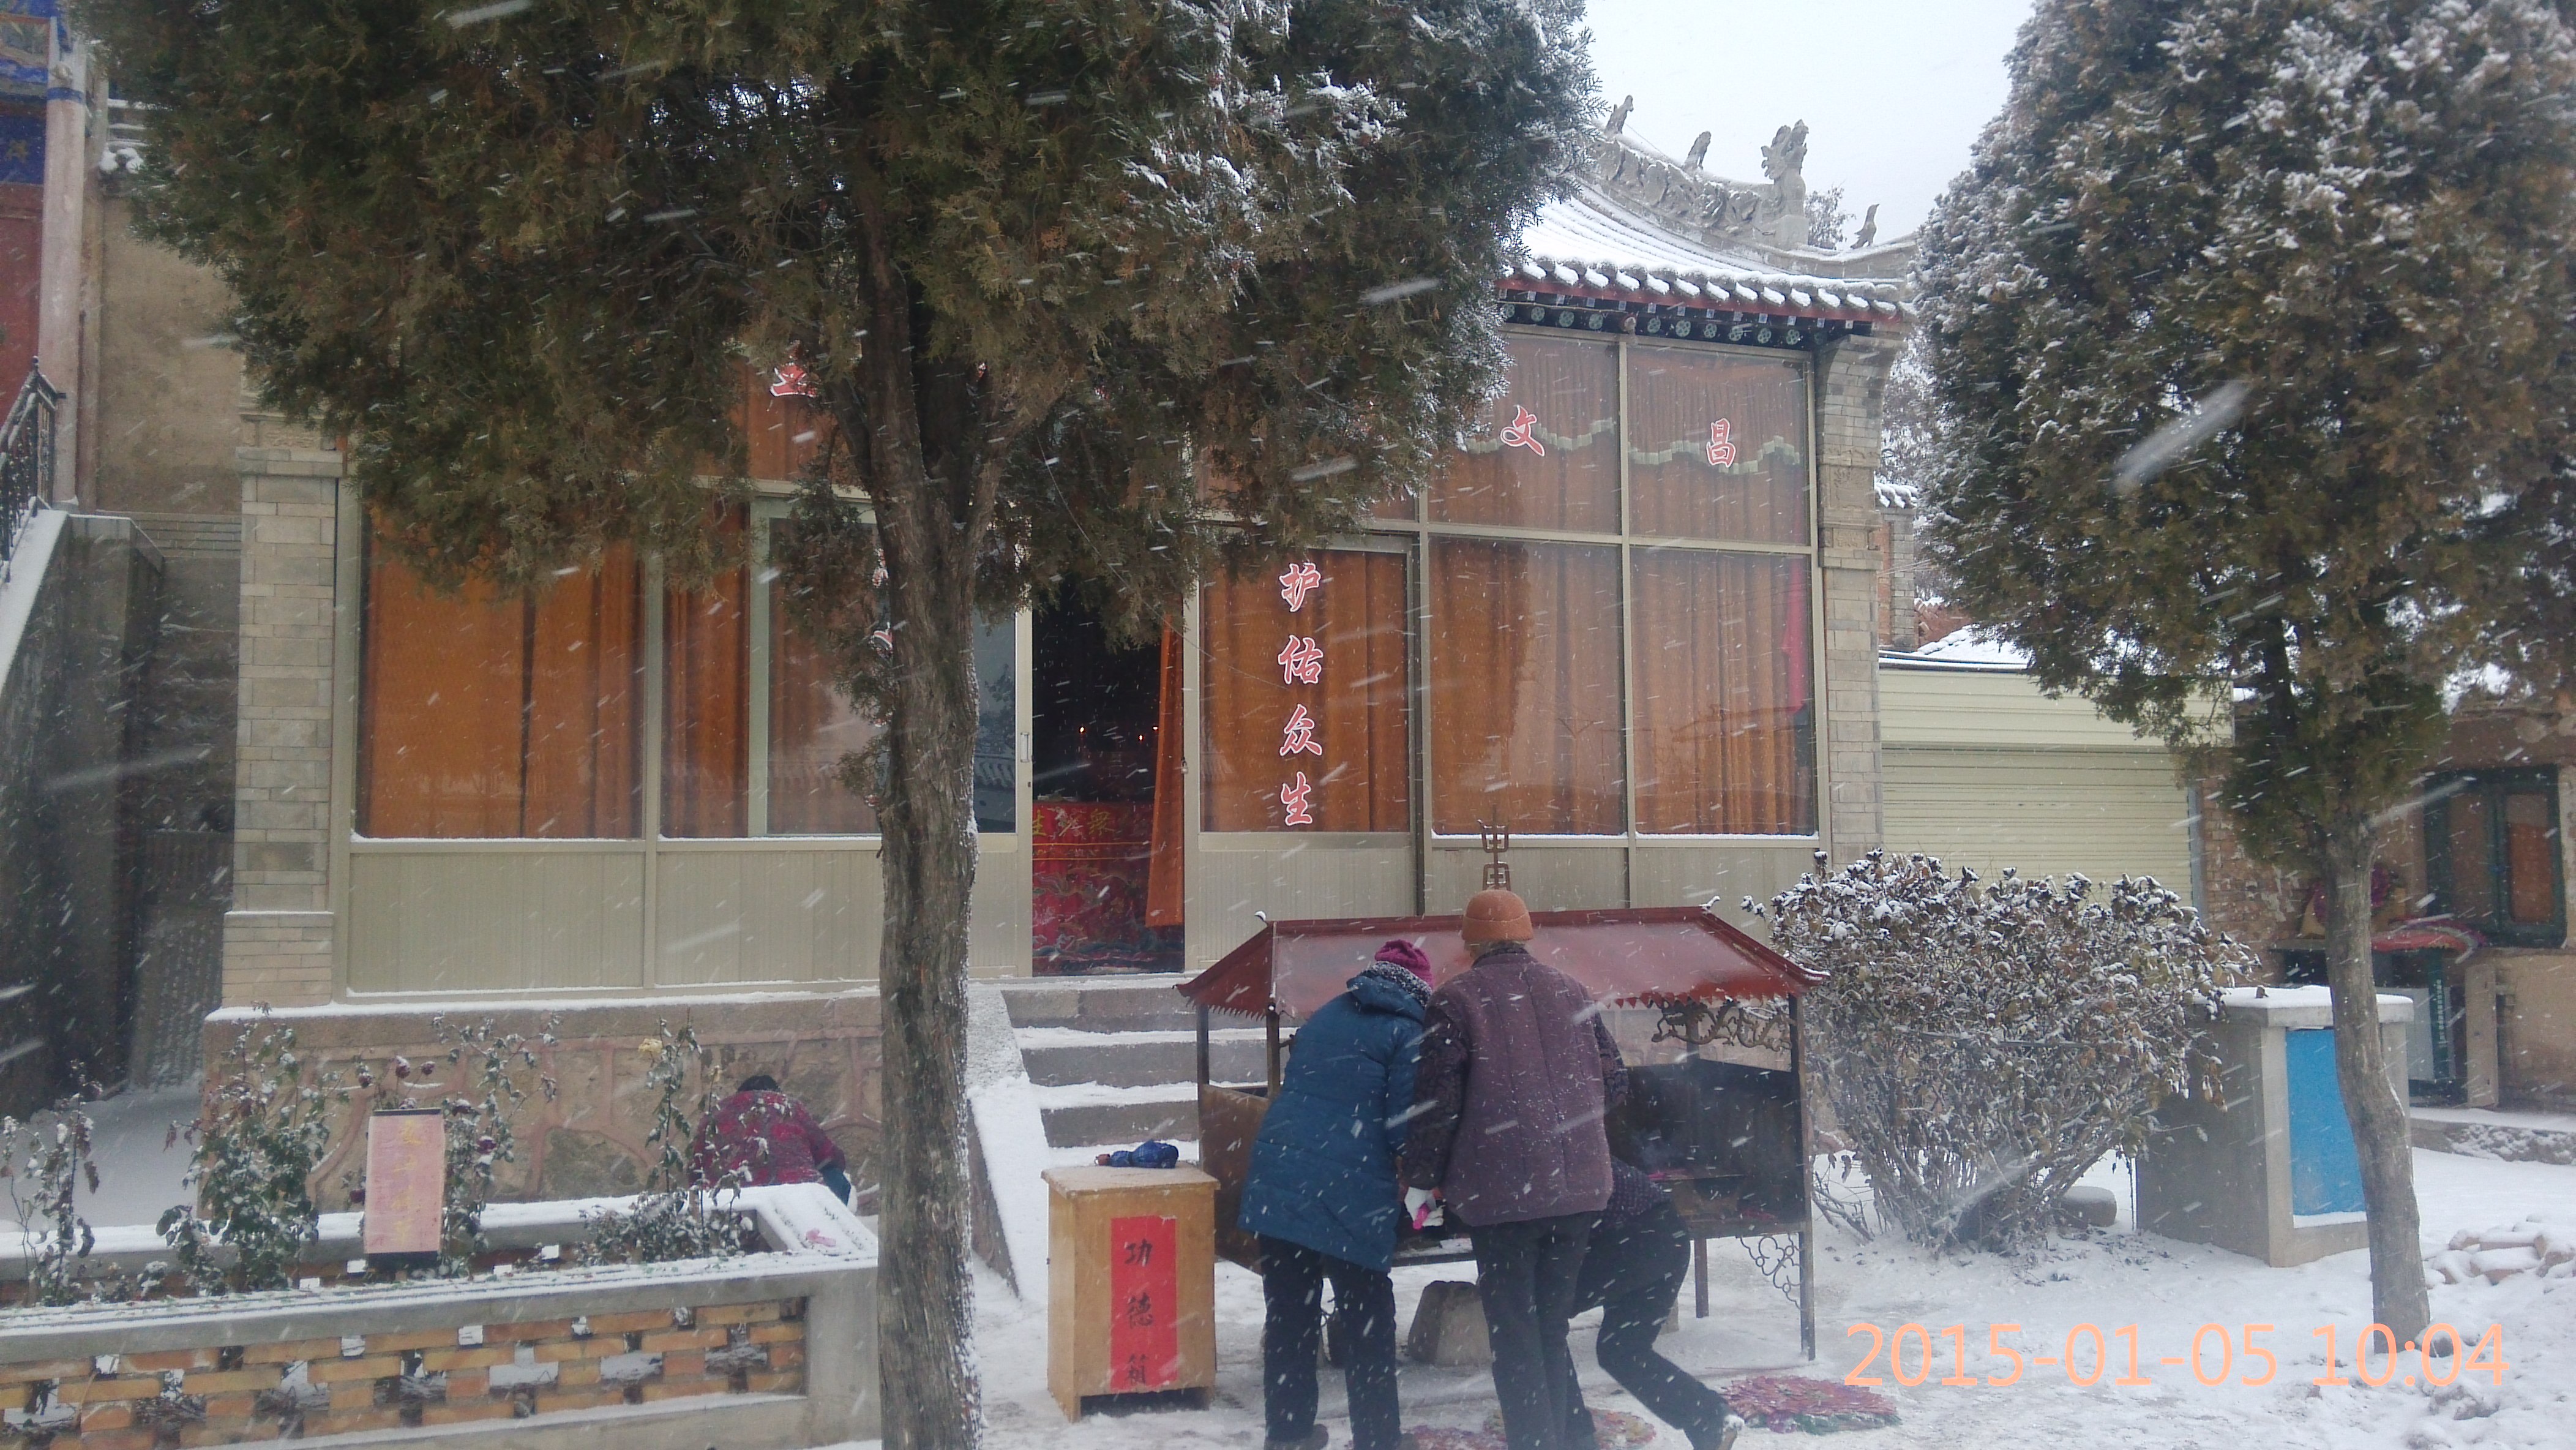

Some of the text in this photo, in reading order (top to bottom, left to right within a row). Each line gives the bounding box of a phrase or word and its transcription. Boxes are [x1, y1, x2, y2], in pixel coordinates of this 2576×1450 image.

[1278, 562, 1324, 827] 护佑众生
[1124, 1238, 1154, 1385] 功德箱
